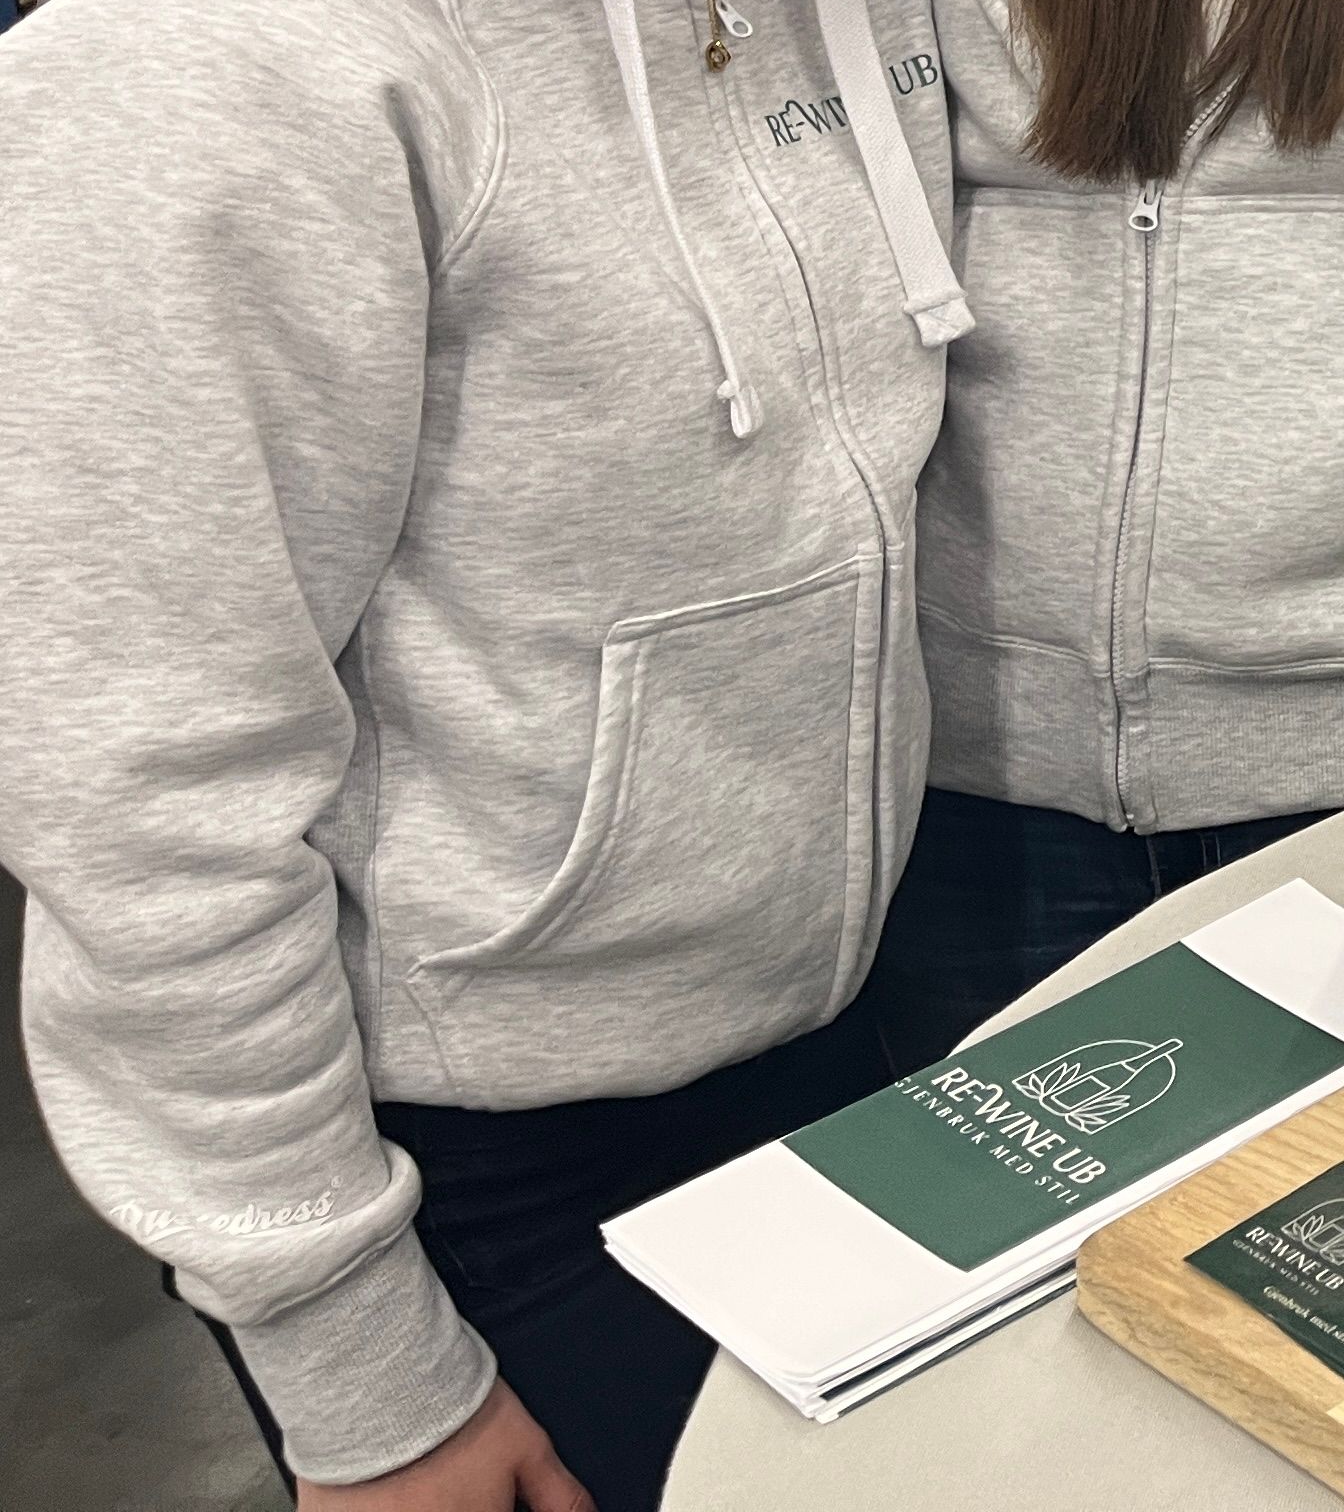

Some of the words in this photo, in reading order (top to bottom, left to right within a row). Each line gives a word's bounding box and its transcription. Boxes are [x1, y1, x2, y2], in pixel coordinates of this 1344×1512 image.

[888, 53, 938, 95] UB
[894, 1076, 991, 1145] GJENBRUK
[989, 1144, 1034, 1175] MED
[1034, 1175, 1080, 1205] STIL
[931, 1067, 1067, 1158] RE-WINE
[1052, 1147, 1107, 1184] UB
[1315, 1268, 1344, 1291] UB
